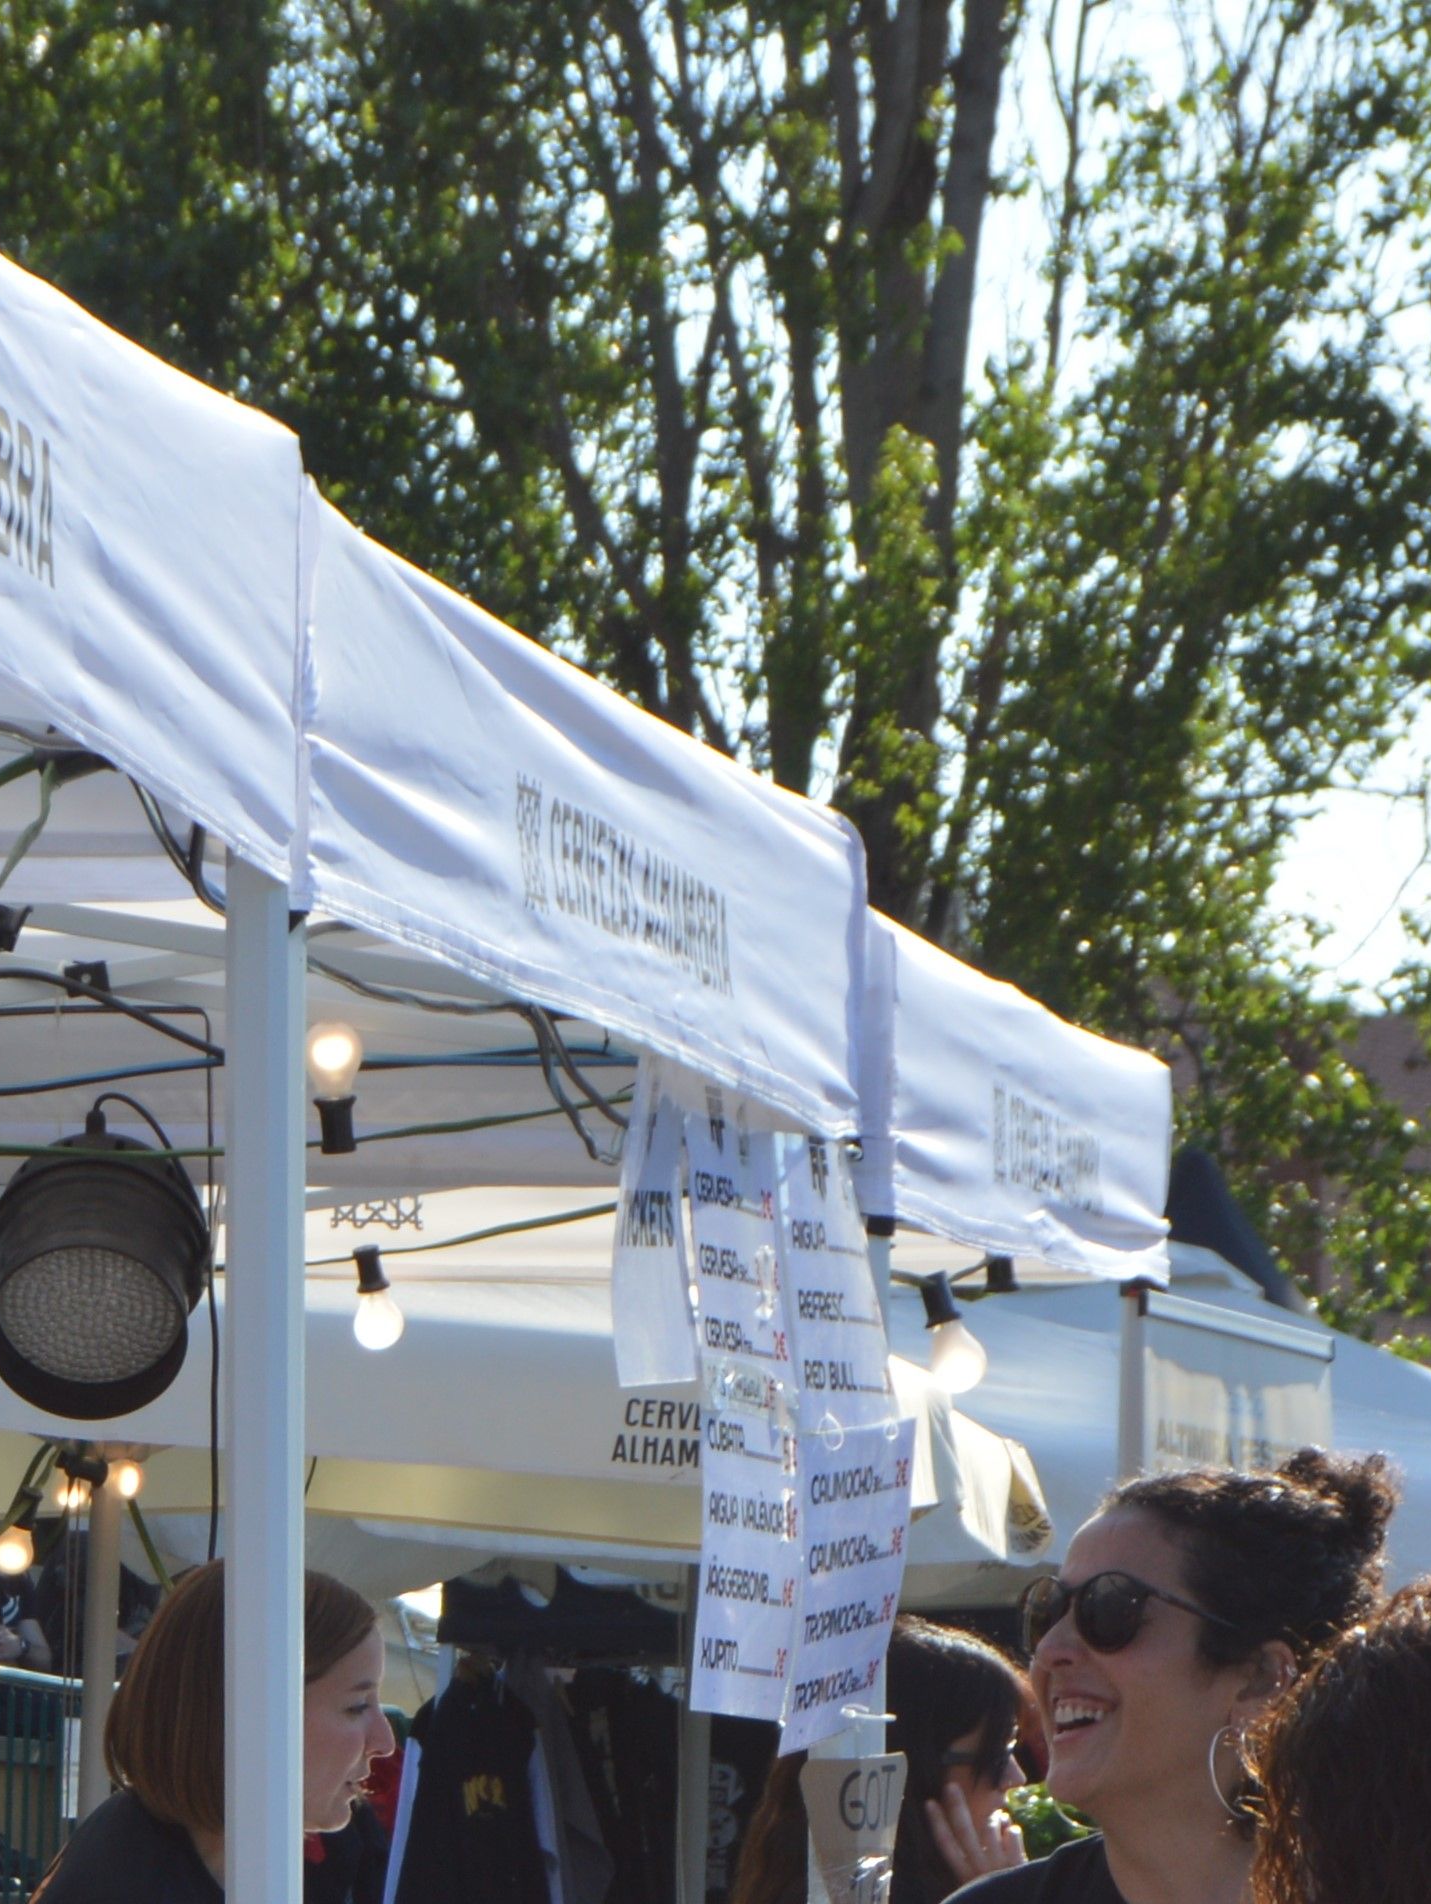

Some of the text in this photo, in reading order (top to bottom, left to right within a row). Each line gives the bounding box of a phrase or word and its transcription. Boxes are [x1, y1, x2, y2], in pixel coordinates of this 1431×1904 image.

[550, 796, 639, 944] CERVEZAS
[792, 1219, 827, 1250] AIGUA
[797, 1289, 846, 1322] REFRESC
[804, 1360, 825, 1388] RED
[830, 1361, 857, 1391] BULL
[707, 1419, 746, 1457] CUBATA
[811, 1465, 873, 1504] CALIMOCHO
[709, 1489, 737, 1524] AIGUA
[809, 1535, 867, 1575] CALIMOCHO
[700, 1636, 740, 1672] XUPITO
[839, 1764, 897, 1832] GOT
